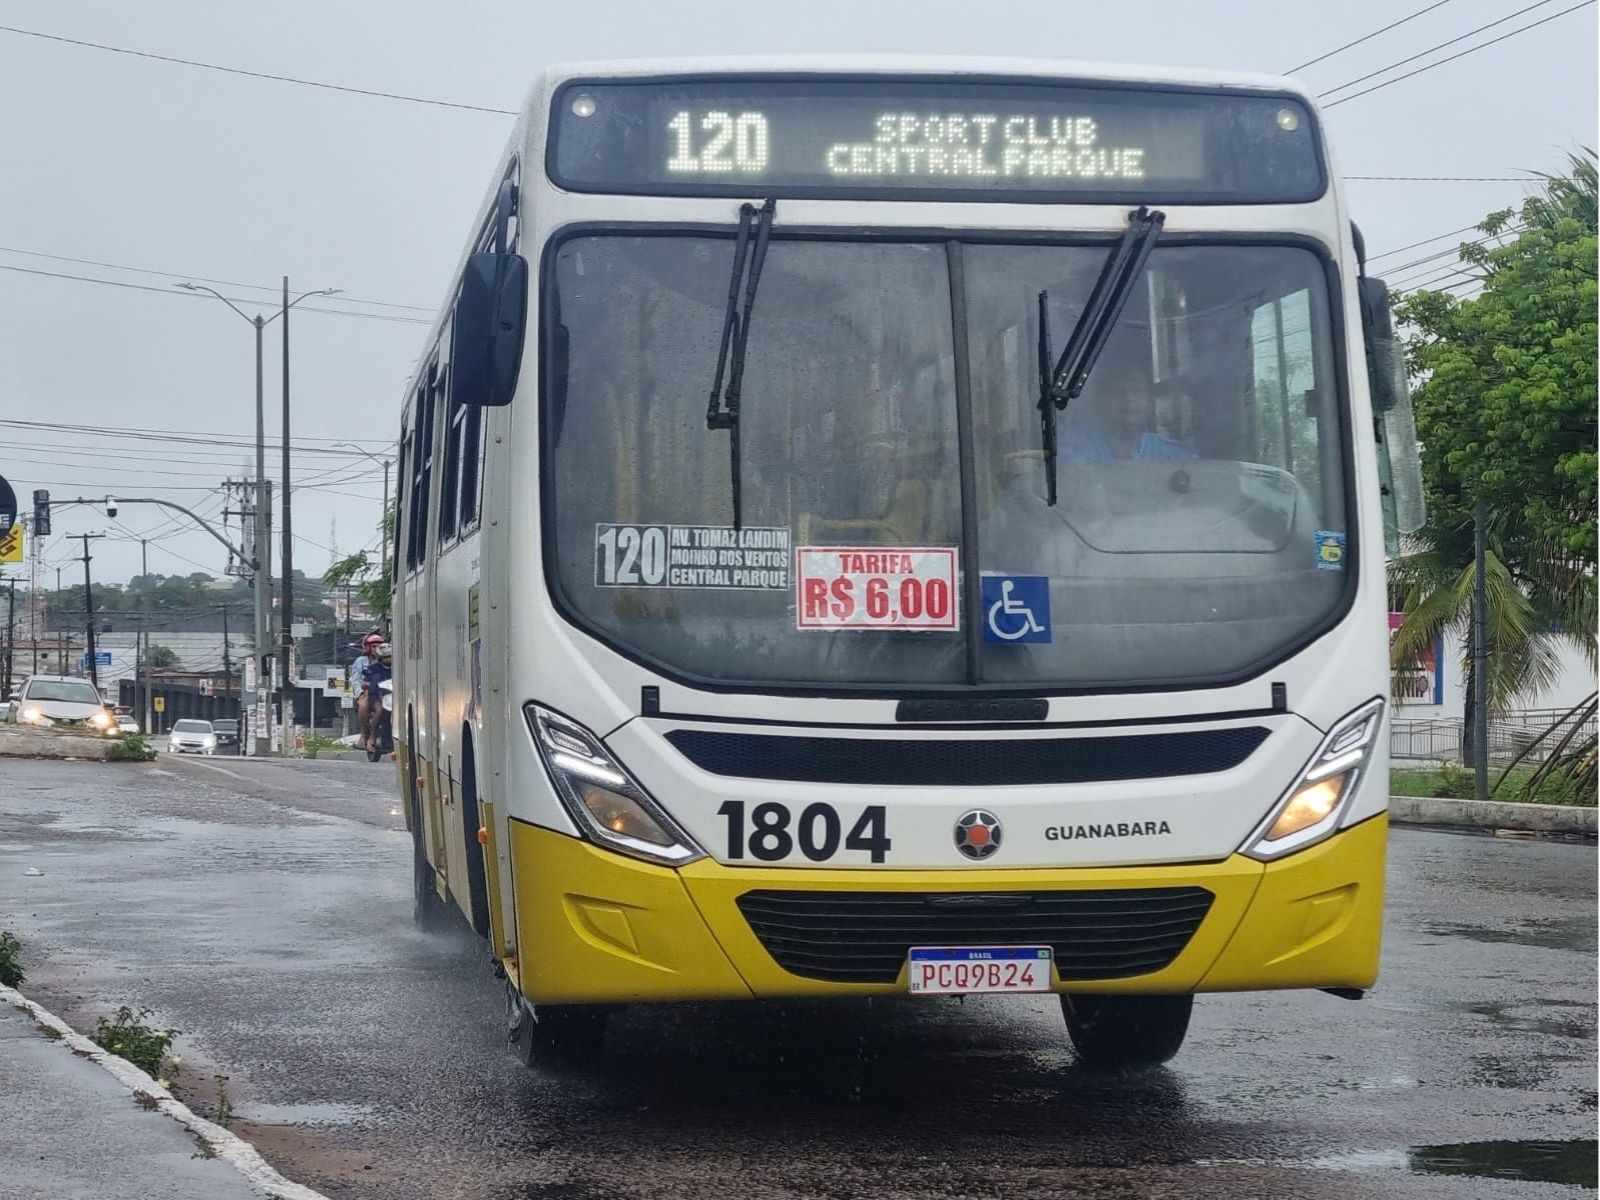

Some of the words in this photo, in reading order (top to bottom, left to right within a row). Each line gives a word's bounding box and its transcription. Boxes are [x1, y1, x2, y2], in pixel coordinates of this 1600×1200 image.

[667, 110, 768, 172] 120
[876, 114, 997, 144] SPORT
[1004, 116, 1097, 145] CLUB
[827, 142, 997, 175] CENTRAL
[1002, 147, 1145, 177] PARQUE
[671, 528, 691, 546] AV.
[693, 529, 737, 548] TOMAZ
[739, 530, 788, 549] LANDIM
[599, 527, 665, 585] 120
[671, 548, 717, 565] MOINHO
[719, 550, 743, 566] DOS
[744, 551, 788, 568] VENTOS
[839, 554, 914, 575] TARIFA
[671, 568, 730, 585] CENTRAL
[733, 570, 787, 588] PARQUE
[805, 575, 855, 622] R$
[866, 578, 948, 622] 6,00
[717, 800, 892, 864] 1804
[1045, 821, 1172, 841] GUANABARA
[922, 963, 1034, 988] PCQ9B24
